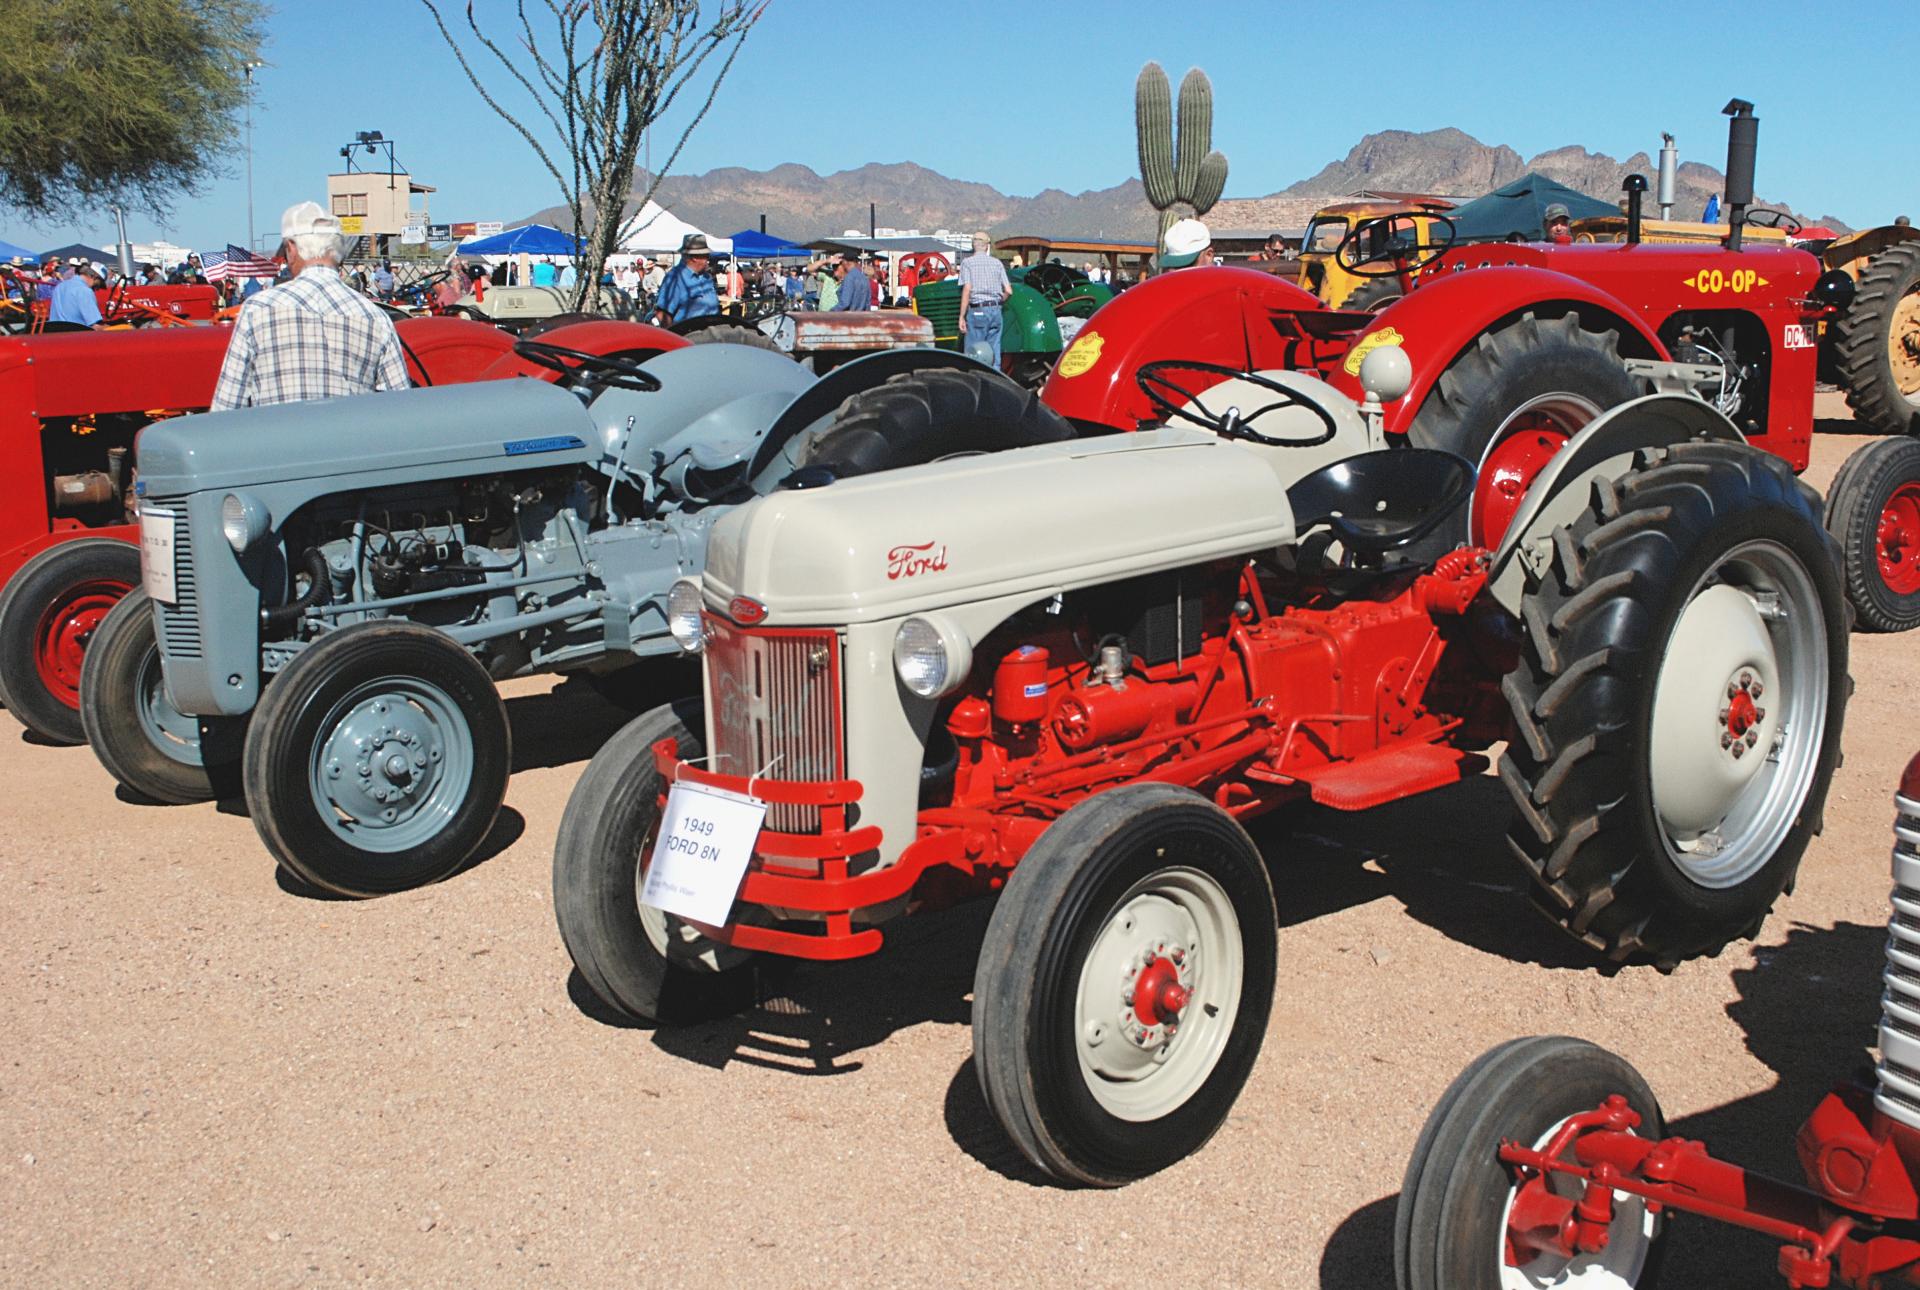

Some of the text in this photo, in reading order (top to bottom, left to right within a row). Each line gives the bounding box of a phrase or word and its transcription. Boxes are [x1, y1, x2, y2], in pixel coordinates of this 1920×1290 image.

[1697, 269, 1756, 293] CO-OP
[888, 541, 948, 579] Ford
[684, 817, 714, 836] 1949
[666, 835, 720, 861] FORD 8N
